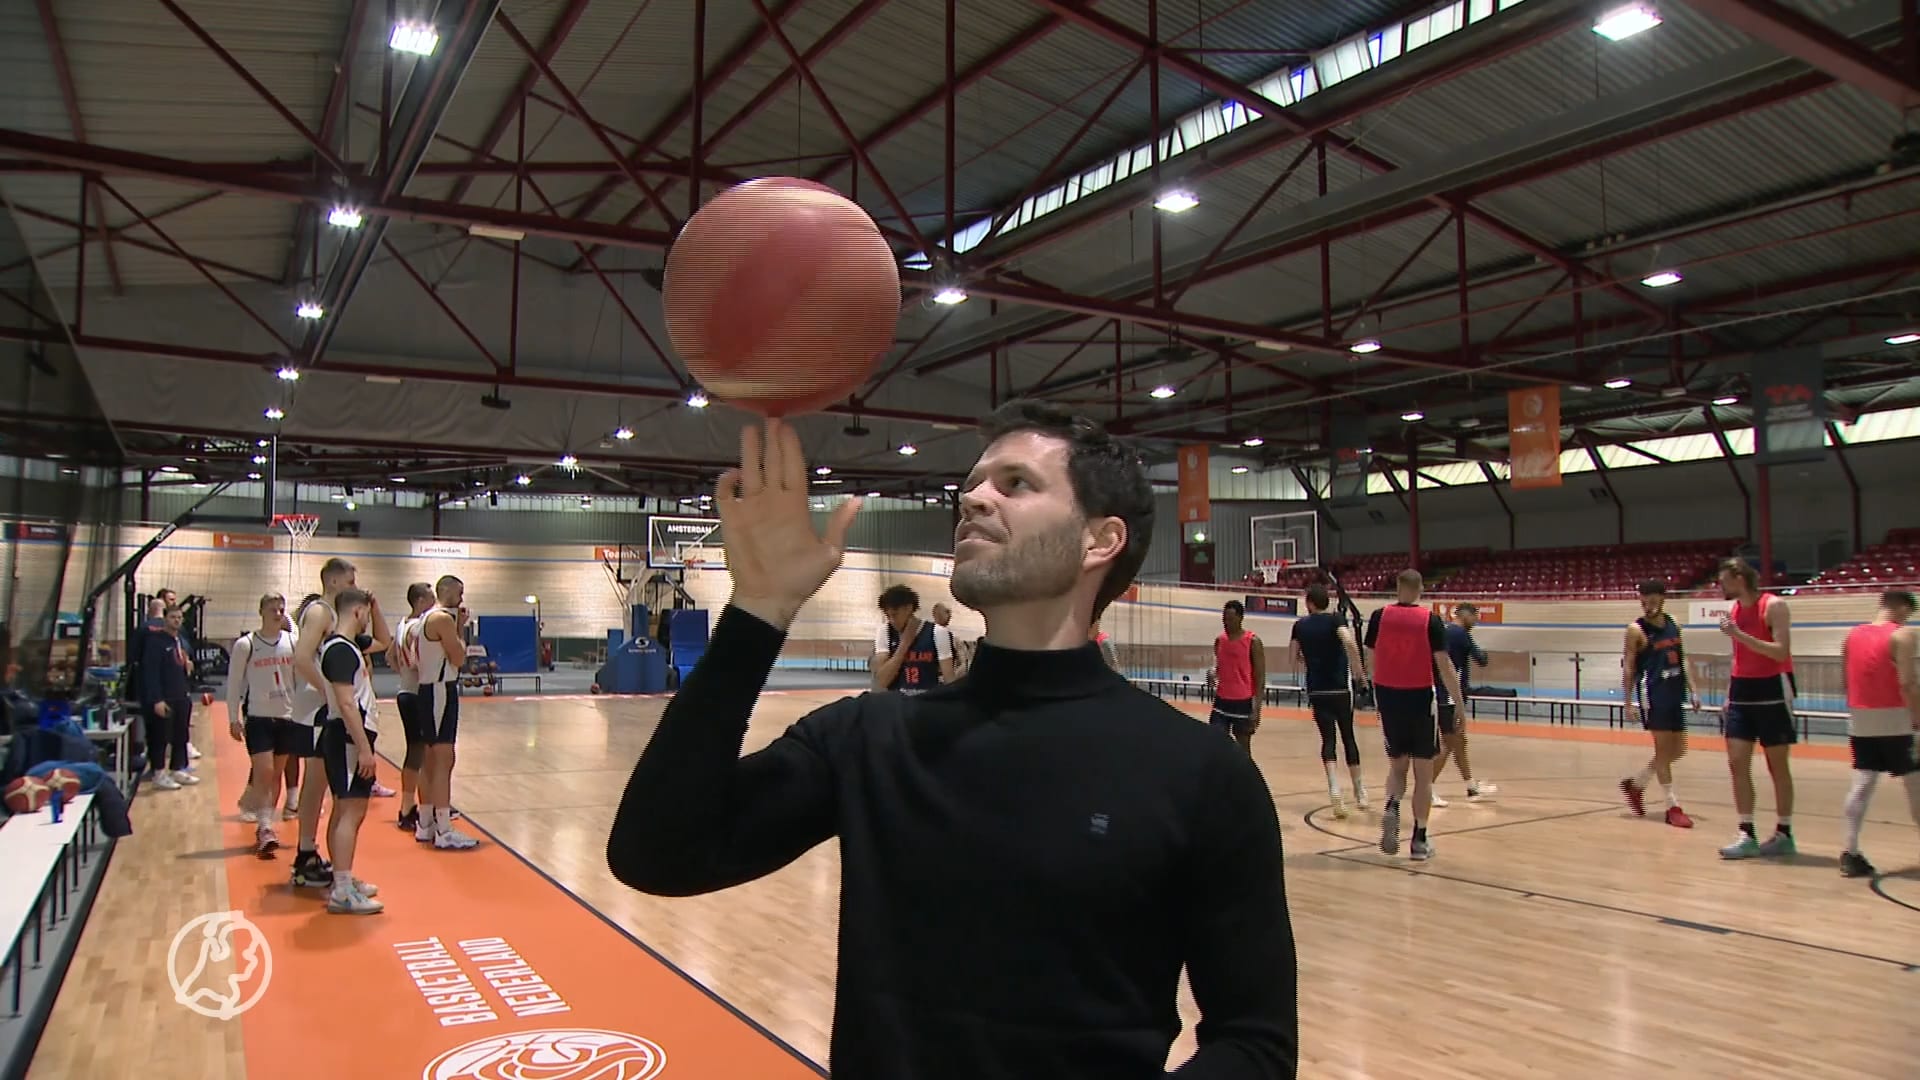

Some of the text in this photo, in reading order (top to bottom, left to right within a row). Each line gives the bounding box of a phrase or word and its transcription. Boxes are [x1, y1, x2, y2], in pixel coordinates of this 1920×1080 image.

[667, 524, 713, 535] AMSTERDAM
[393, 936, 498, 1027] BASKETBALL
[457, 936, 571, 1017] NEDERLAND
